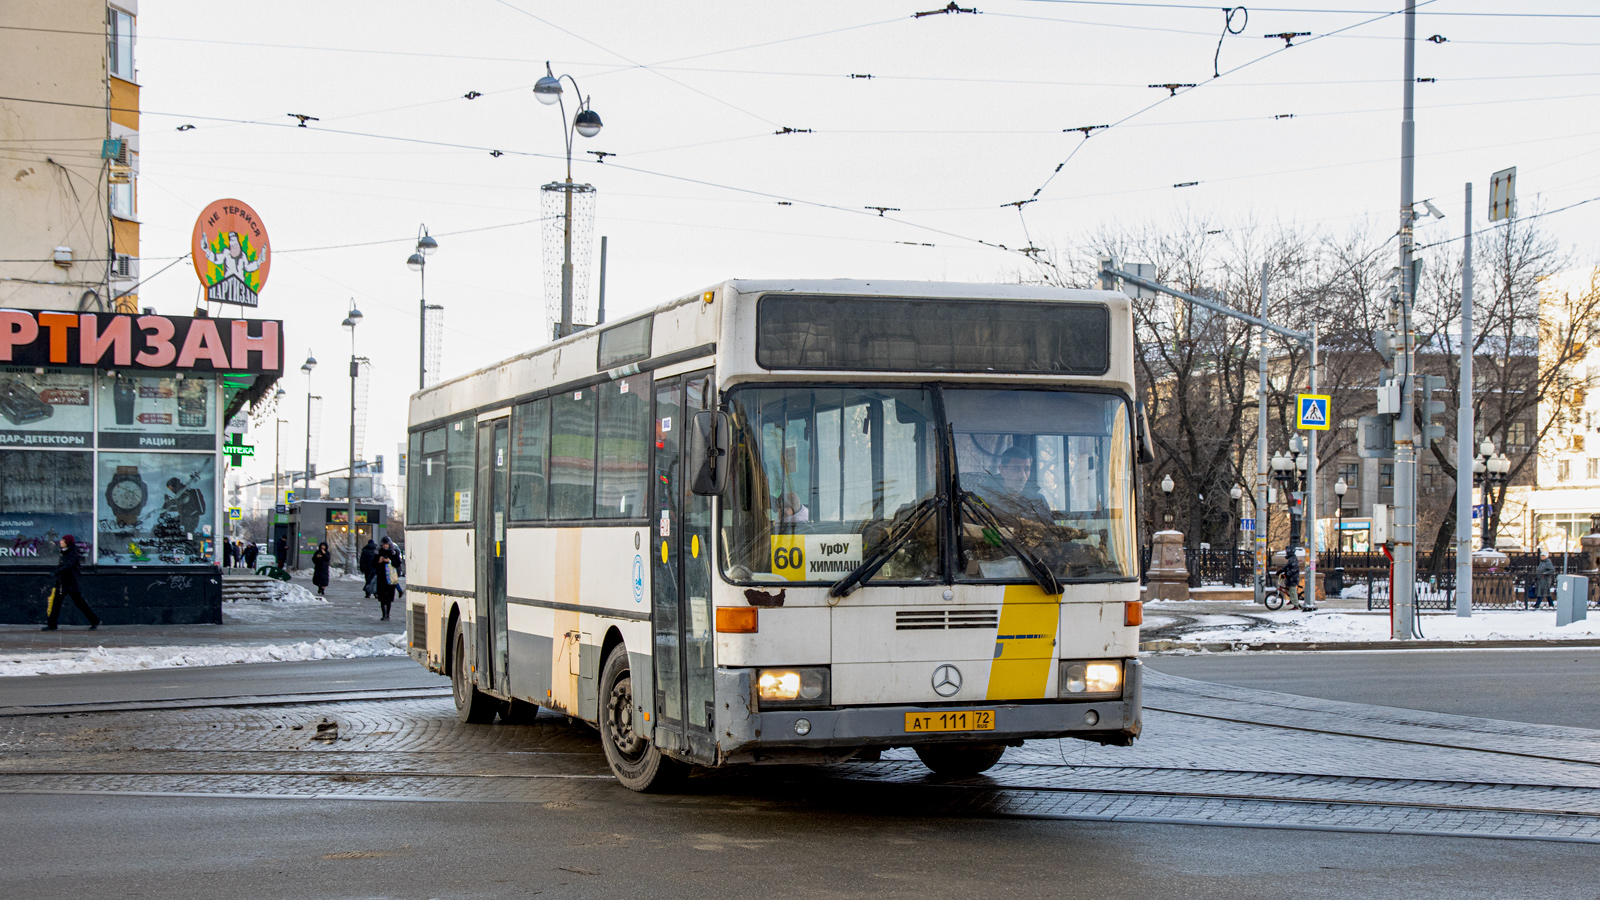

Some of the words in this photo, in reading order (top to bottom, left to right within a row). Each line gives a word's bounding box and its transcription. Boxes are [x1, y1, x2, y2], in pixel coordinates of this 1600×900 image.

[207, 211, 221, 227] НЕ
[222, 205, 262, 238] ТЕРЯЙСЯ
[209, 278, 258, 305] ПАРТИЗАН
[0, 310, 279, 370] РТИЗАН
[139, 437, 176, 446] РАЦИИ
[774, 546, 803, 570] 60
[820, 542, 850, 557] УрФУ
[809, 560, 861, 573] ХИММАШ
[939, 713, 966, 729] 111
[975, 711, 990, 724] 72
